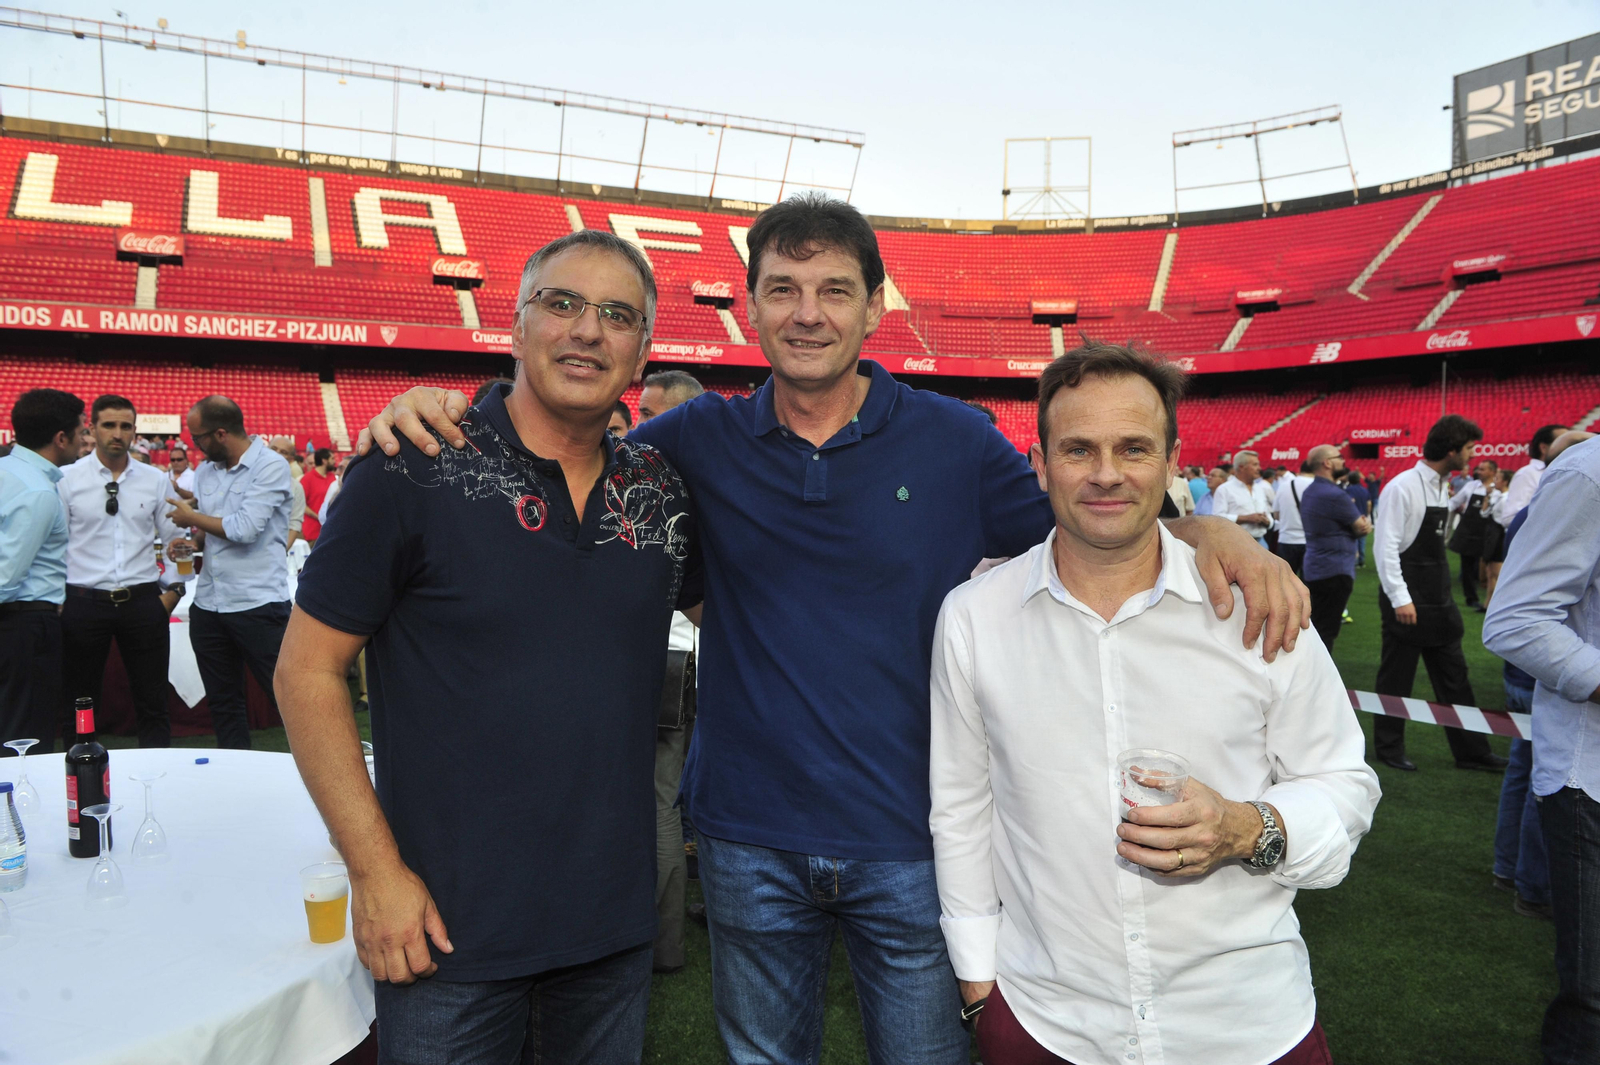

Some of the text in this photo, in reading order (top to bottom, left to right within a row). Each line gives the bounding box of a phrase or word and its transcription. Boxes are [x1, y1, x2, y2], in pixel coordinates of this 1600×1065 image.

[1524, 87, 1600, 124] SEGU
[310, 153, 327, 164] por
[329, 155, 347, 166] eso
[349, 157, 368, 169] que
[369, 158, 387, 172] hoy
[400, 163, 429, 176] vengo
[1418, 171, 1448, 186] Sevilla
[60, 308, 90, 328] AL
[100, 311, 178, 333] RAMON
[184, 315, 367, 342] SANCHEZ-PIZJUAN
[651, 343, 694, 356] ruzcampo
[1351, 429, 1402, 439] CORDIALITY
[1271, 447, 1300, 460] bwin
